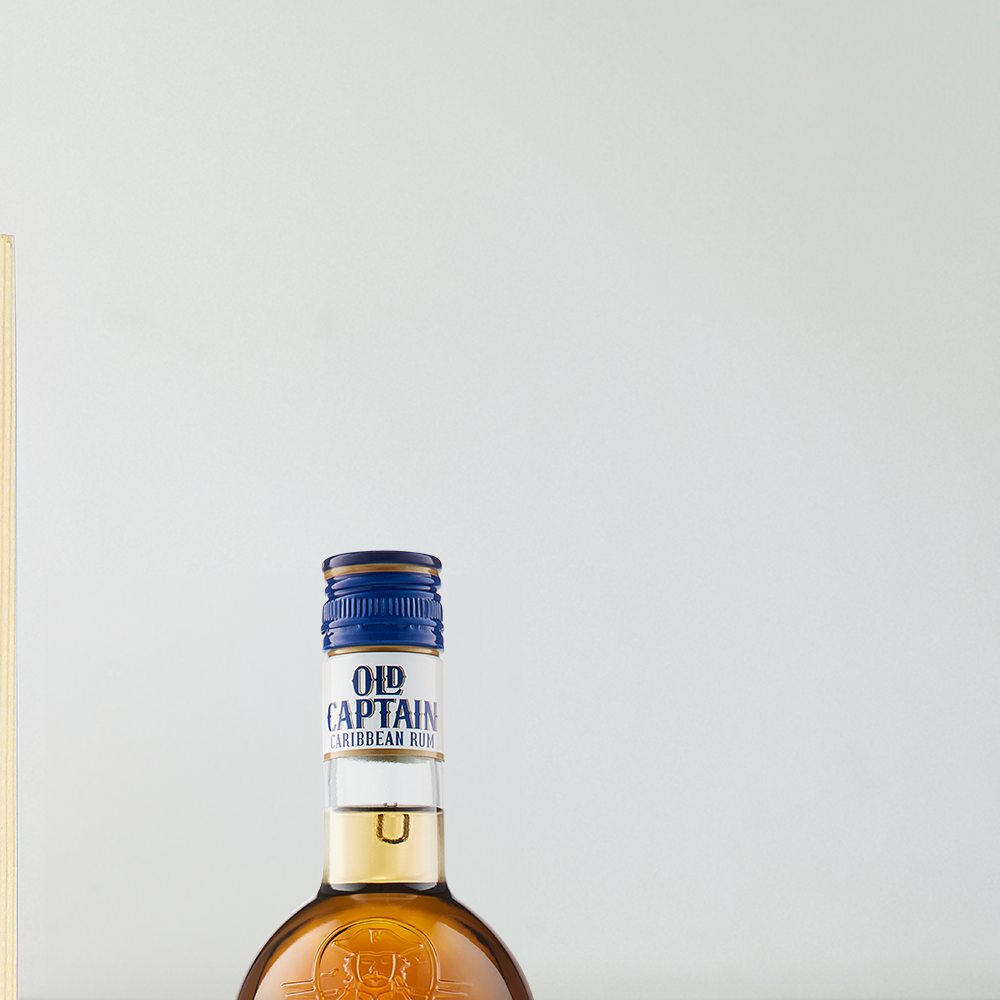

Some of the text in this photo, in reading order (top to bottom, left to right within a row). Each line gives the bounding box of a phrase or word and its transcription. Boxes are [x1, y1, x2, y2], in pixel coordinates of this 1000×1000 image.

[352, 665, 407, 696] OLD
[327, 698, 438, 732] CAPTAIN
[330, 731, 435, 749] CARIBBEAN RUM
